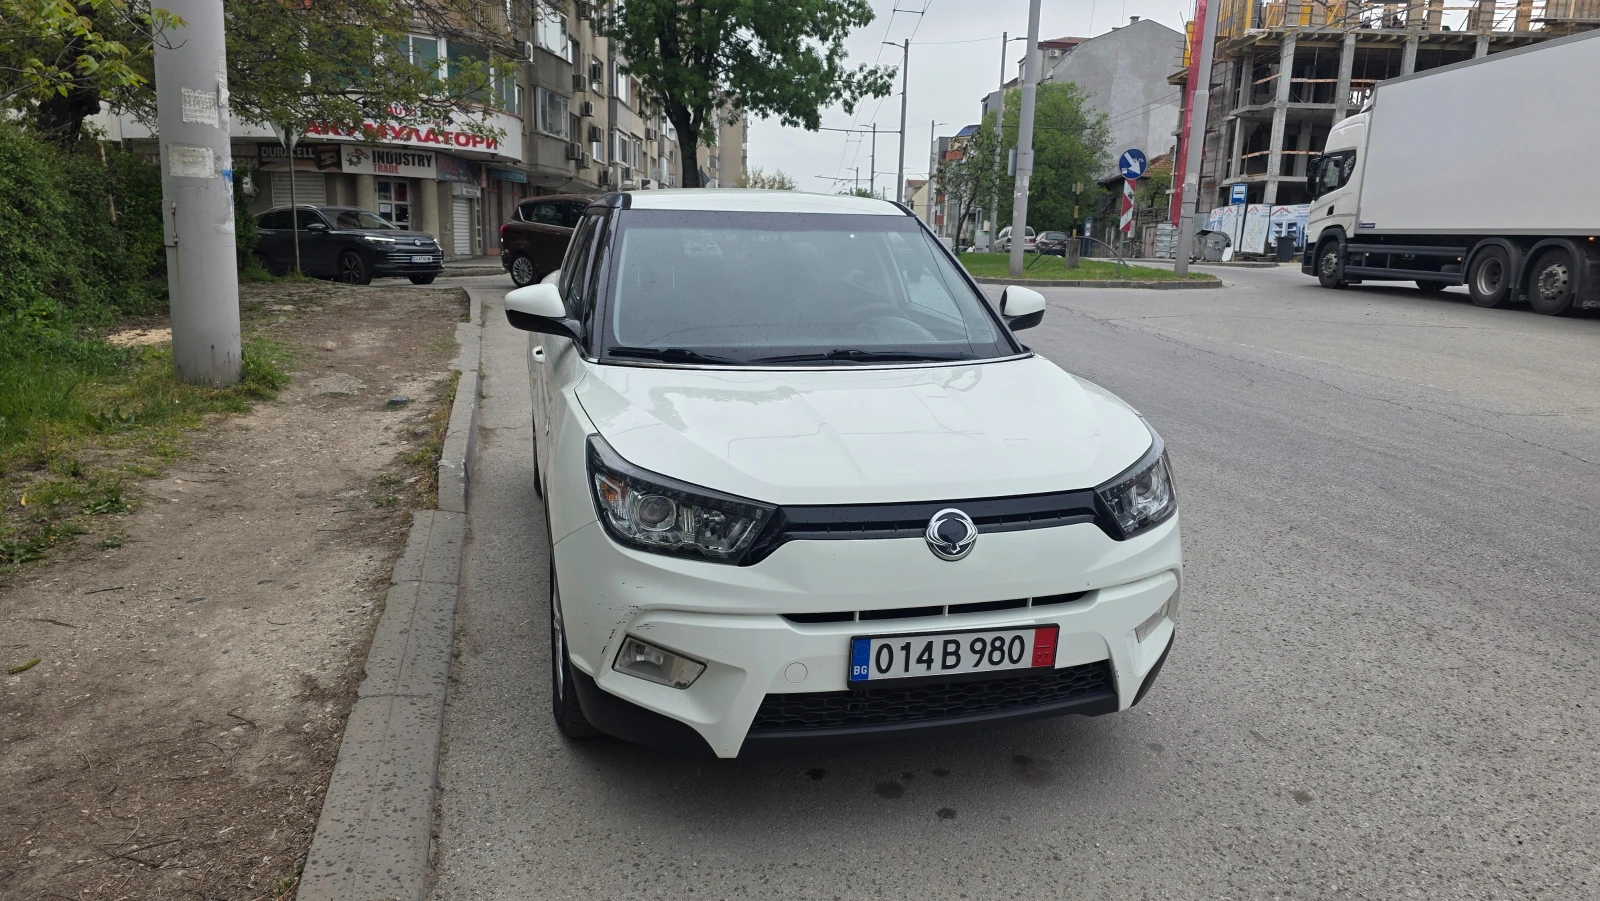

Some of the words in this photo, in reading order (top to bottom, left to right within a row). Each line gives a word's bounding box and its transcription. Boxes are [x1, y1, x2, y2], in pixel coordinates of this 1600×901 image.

[261, 146, 315, 158] DURACELL
[372, 150, 432, 168] INDUSTRY
[373, 164, 399, 174] TRADE
[875, 641, 934, 675] 014
[941, 639, 962, 671] B
[969, 635, 1026, 667] 980
[1036, 651, 1050, 663] 27
[853, 665, 868, 676] BG
